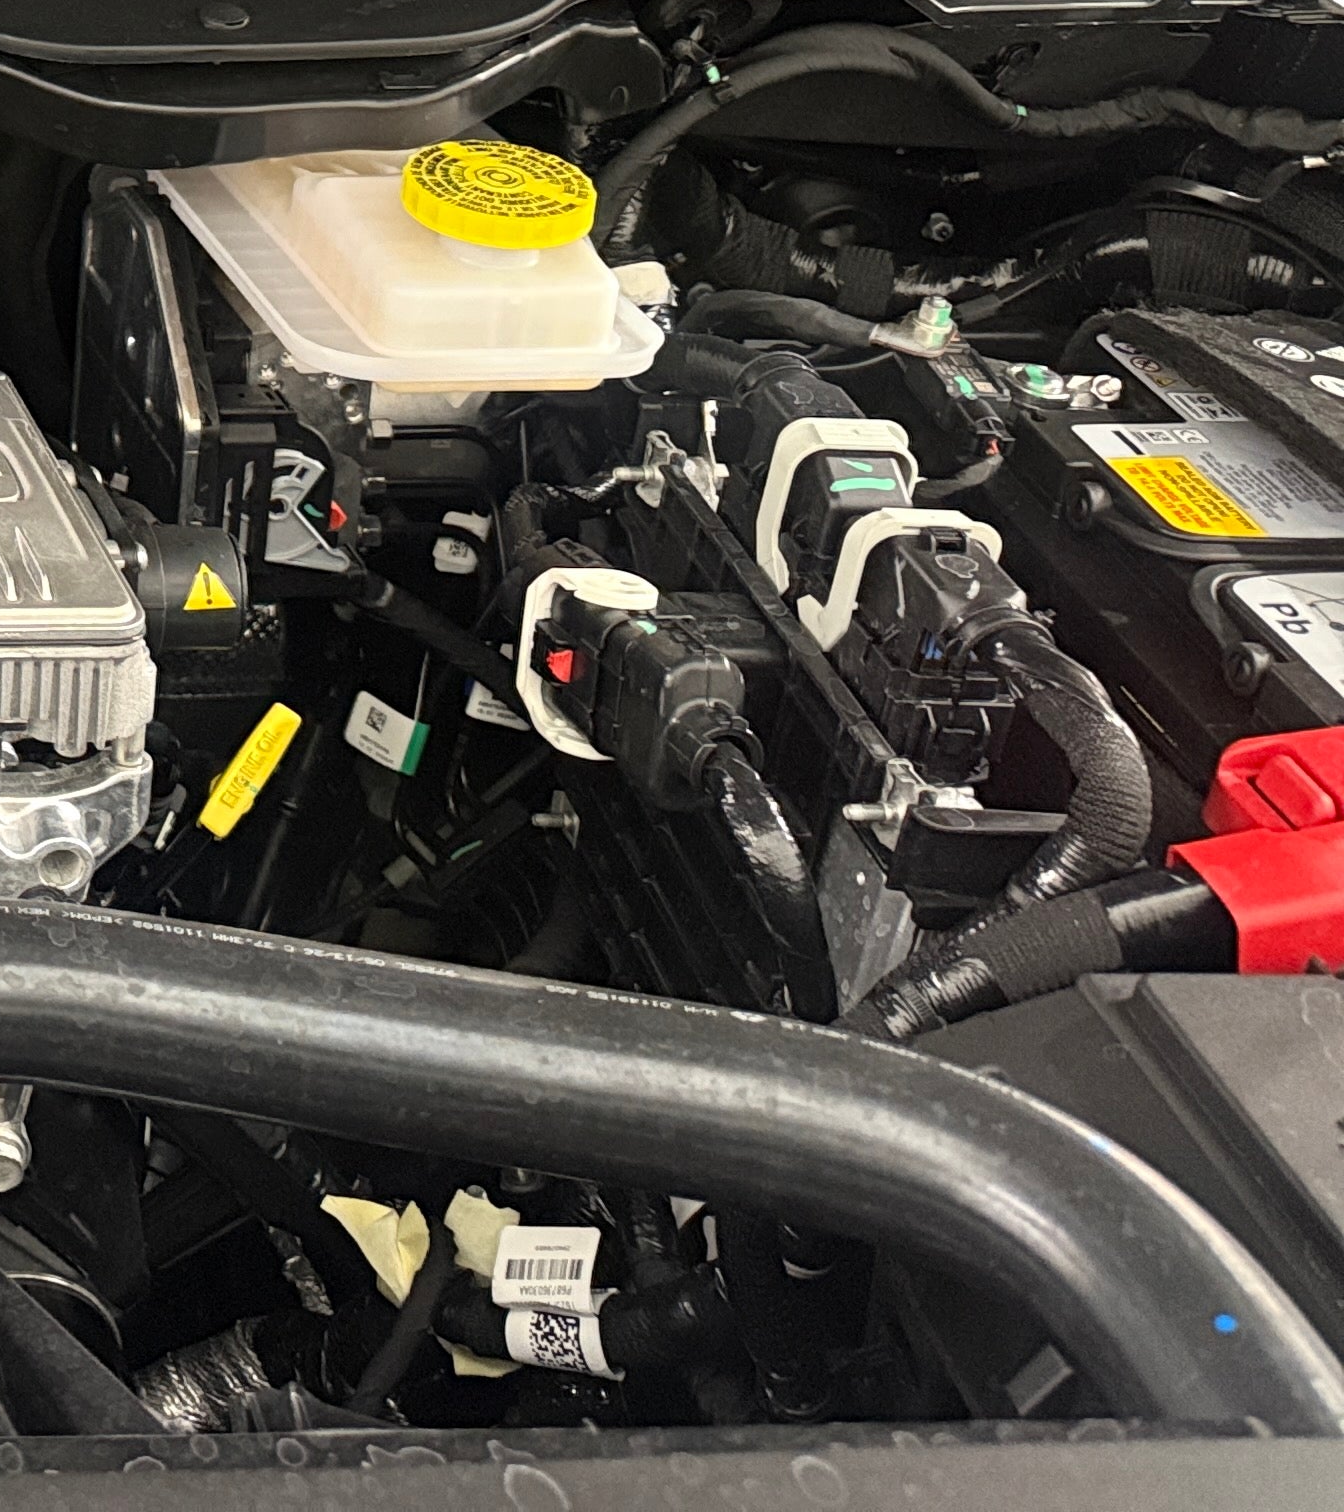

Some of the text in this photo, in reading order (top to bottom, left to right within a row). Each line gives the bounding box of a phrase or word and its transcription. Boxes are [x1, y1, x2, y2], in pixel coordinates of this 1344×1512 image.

[1260, 603, 1312, 634] Pb
[220, 730, 281, 808] ENGINE OIL
